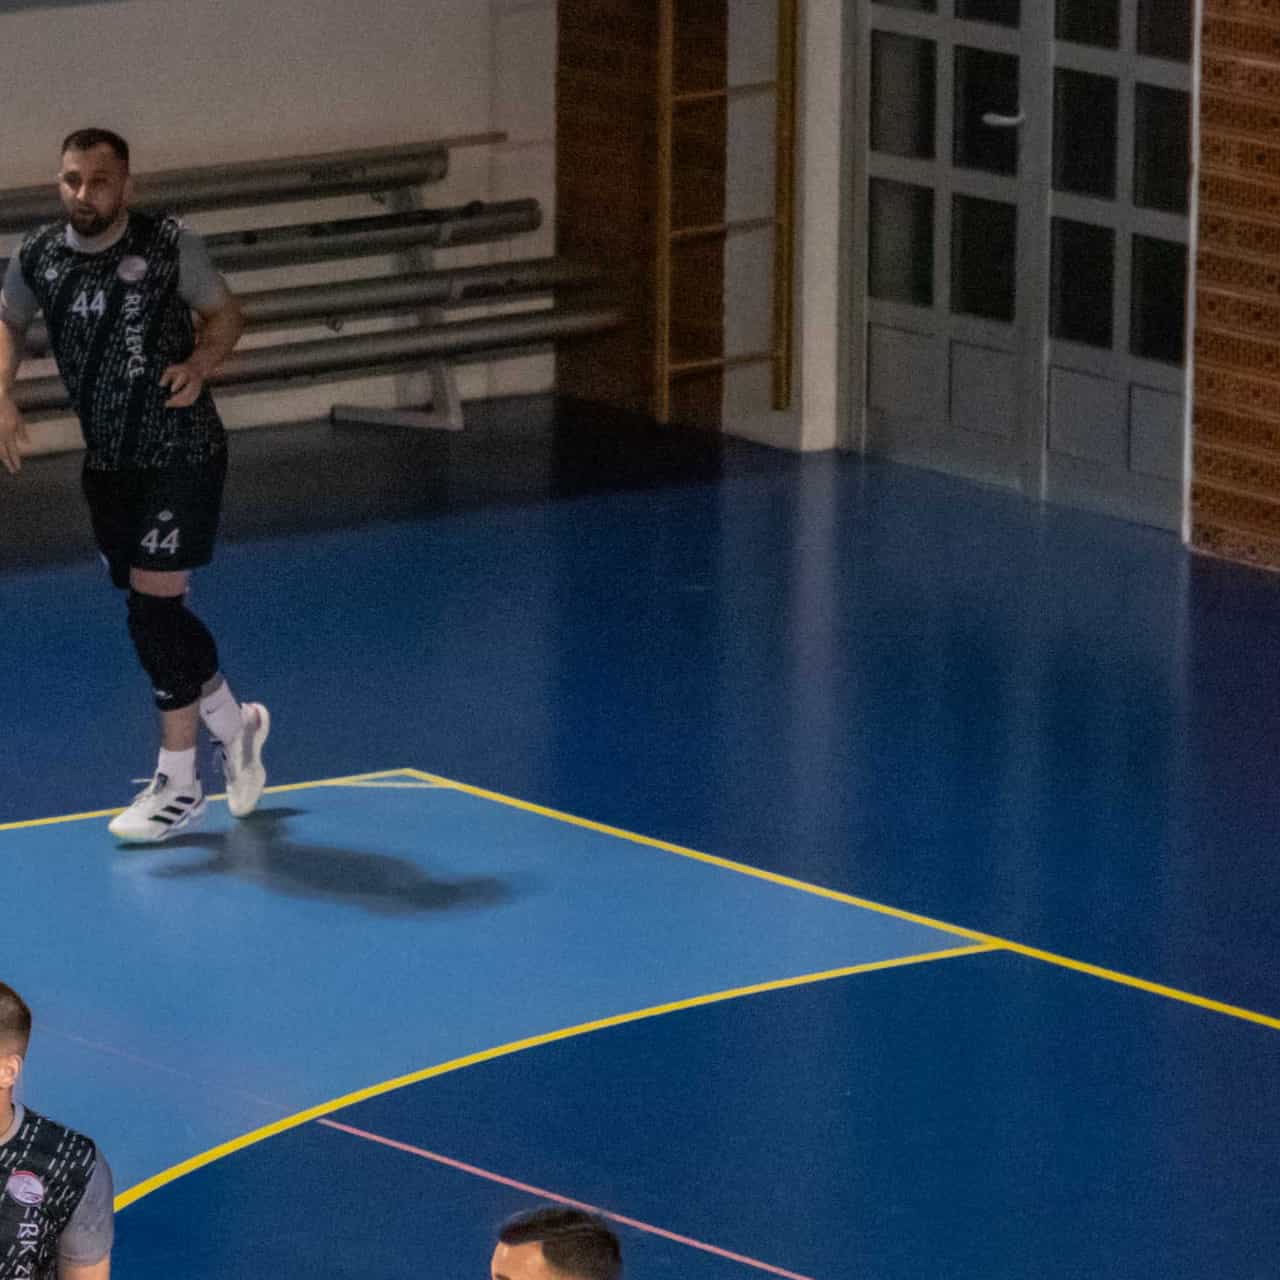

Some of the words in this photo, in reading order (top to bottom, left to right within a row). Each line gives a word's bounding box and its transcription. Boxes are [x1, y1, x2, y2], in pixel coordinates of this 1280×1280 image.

[72, 290, 107, 319] 44
[140, 528, 180, 555] 44
[17, 1223, 39, 1258] RK
